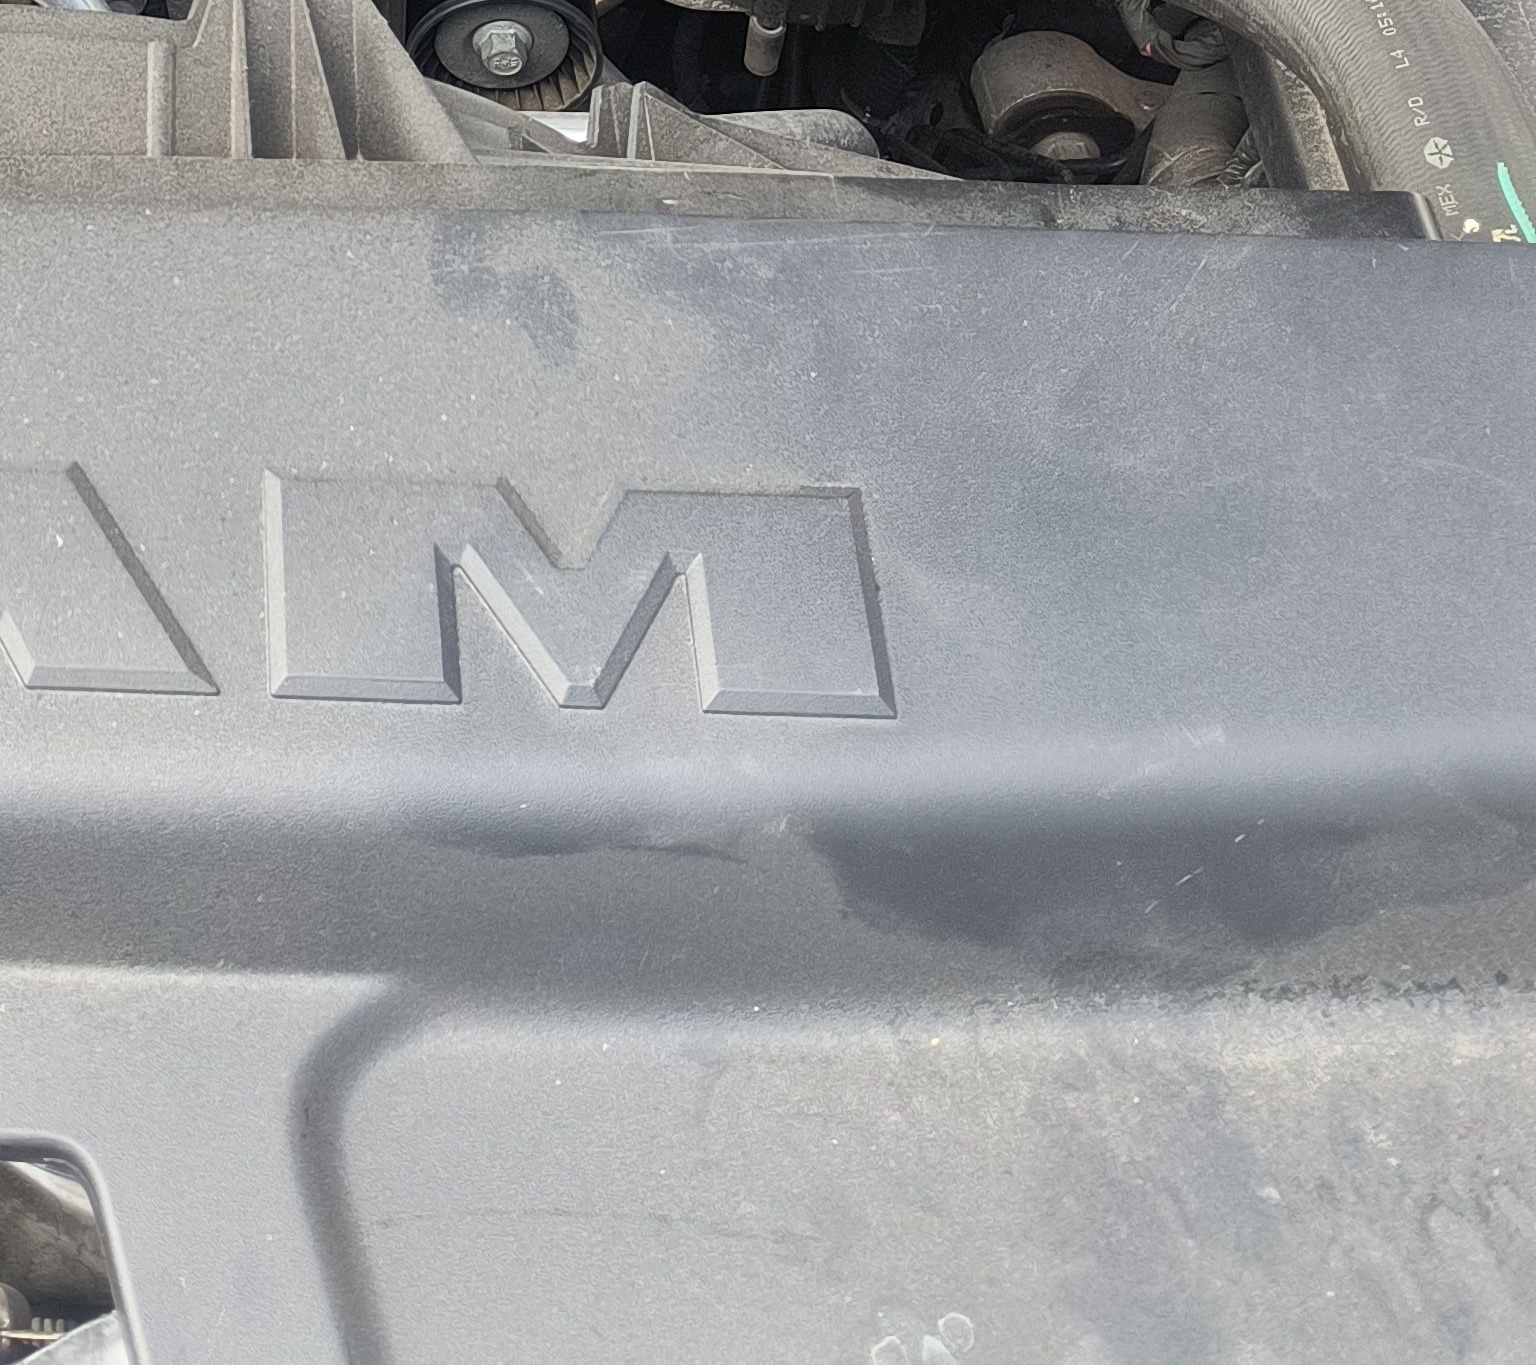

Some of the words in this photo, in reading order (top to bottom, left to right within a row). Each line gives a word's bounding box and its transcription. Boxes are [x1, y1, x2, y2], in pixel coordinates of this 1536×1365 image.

[1390, 49, 1410, 69] L4
[1408, 96, 1431, 126] R/D
[1435, 184, 1460, 217] MEX
